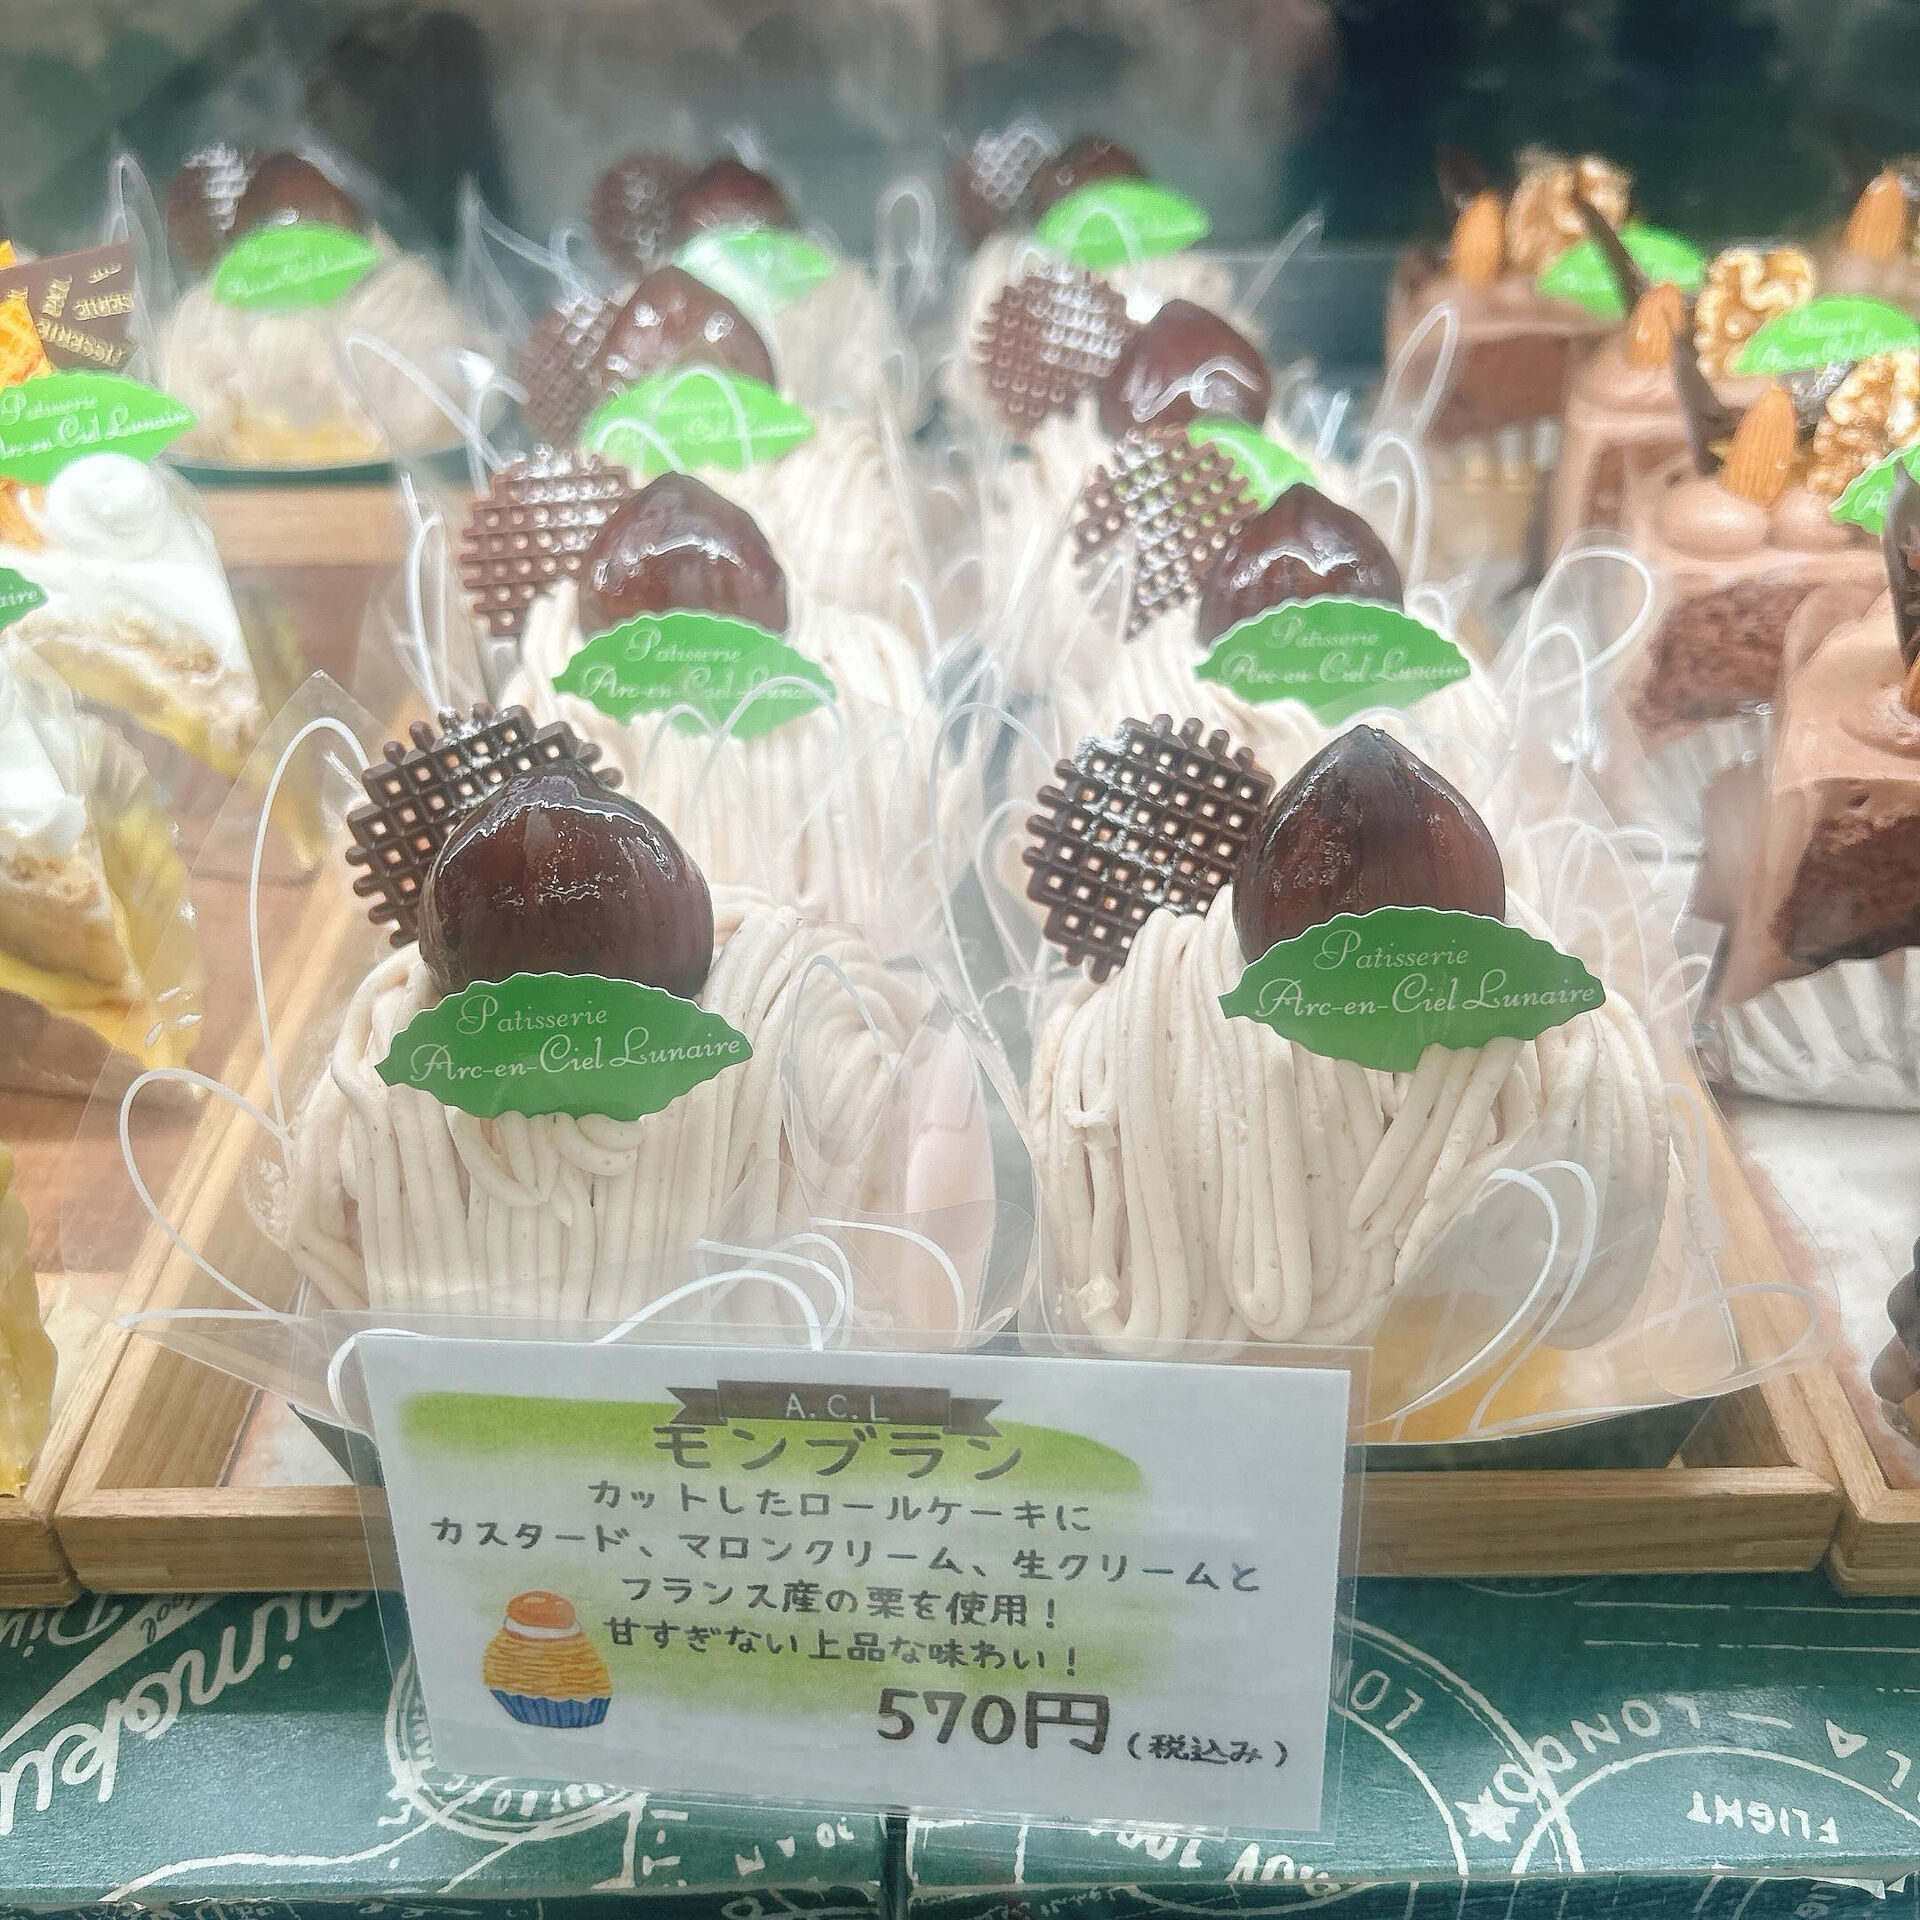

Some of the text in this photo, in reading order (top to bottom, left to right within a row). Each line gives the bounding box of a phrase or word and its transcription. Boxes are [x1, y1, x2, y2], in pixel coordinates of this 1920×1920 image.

[1314, 929, 1469, 970] Patisserie
[456, 994, 608, 1035] Patisserie
[1255, 968, 1595, 1018] Arc-en-Ciel Lunaire
[410, 1026, 741, 1082] Arc-en-Ciel Lunaire
[785, 1392, 890, 1422] A.C.L
[653, 1424, 1023, 1481] モンブラン
[588, 1479, 1092, 1532] カットしたロールケーキに
[431, 1516, 1260, 1593] カスタード、マロンクリーム、生クリームと
[621, 1576, 1057, 1629] フランス産の栗を使用！
[603, 1615, 1077, 1677] 甘すぎない上品な味わい！
[877, 1687, 1289, 1768] 570円 （税込み）
[1687, 1791, 1840, 1845] FLIGHT
